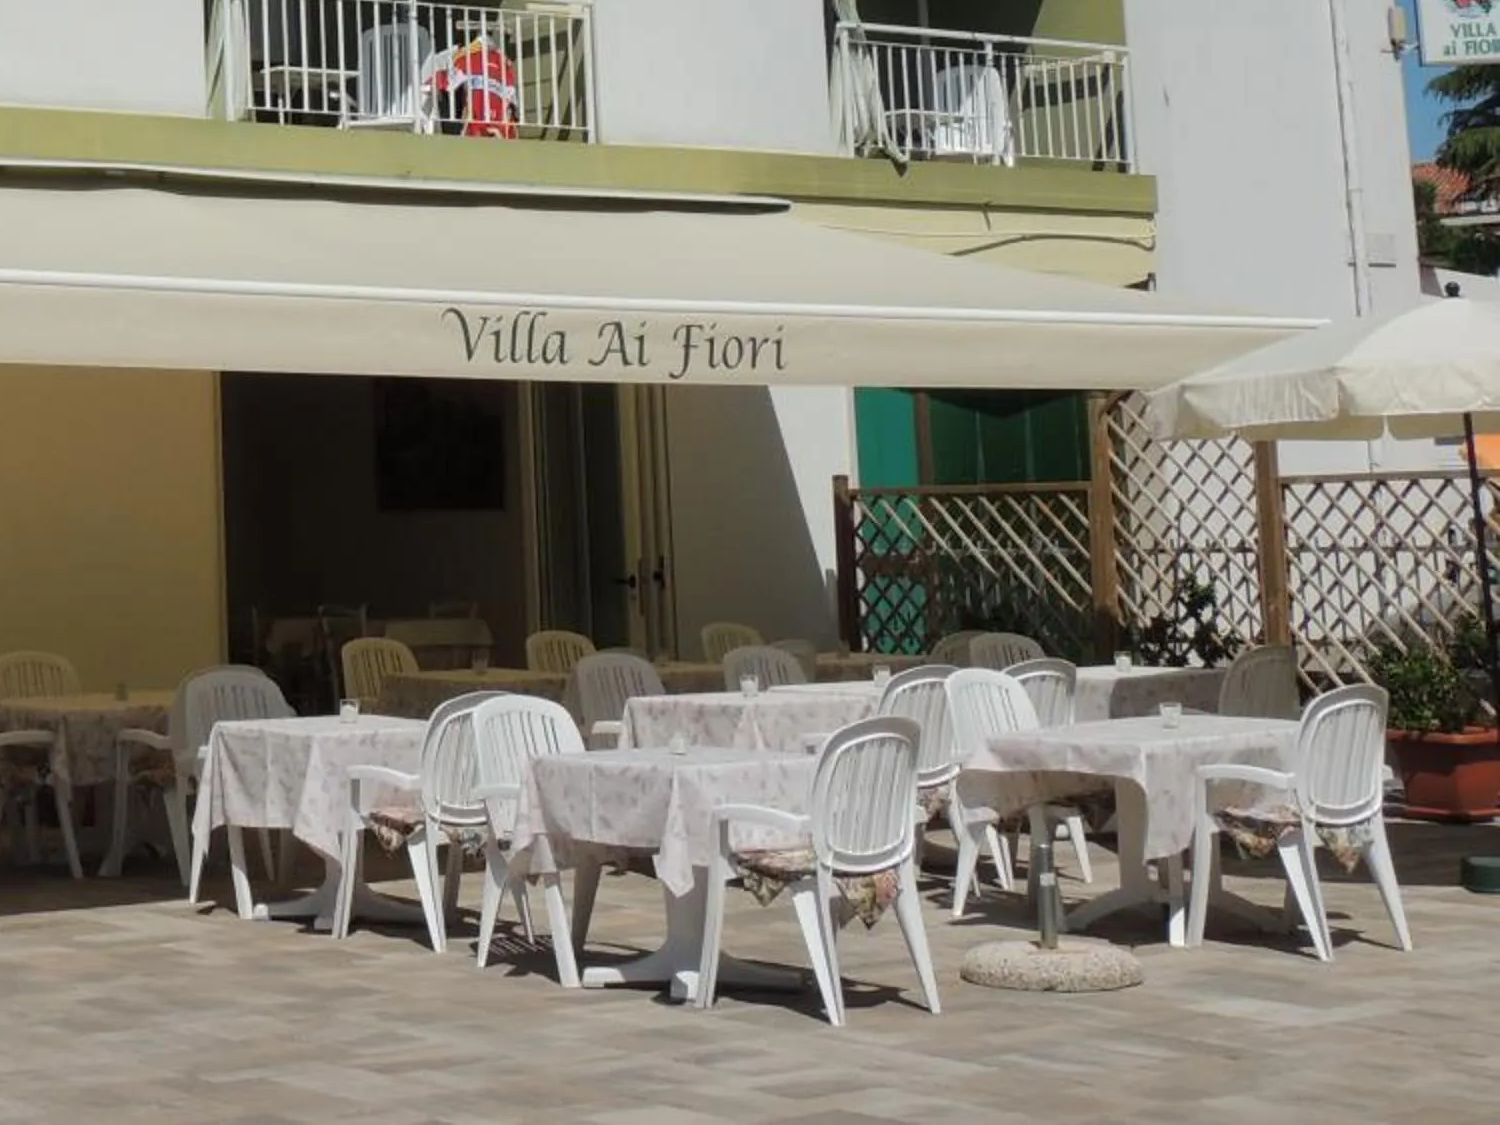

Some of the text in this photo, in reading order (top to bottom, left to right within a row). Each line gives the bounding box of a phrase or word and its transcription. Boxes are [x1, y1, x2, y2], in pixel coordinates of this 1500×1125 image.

[1449, 22, 1497, 38] VILLA
[441, 307, 787, 380] Villa Ai Fiori
